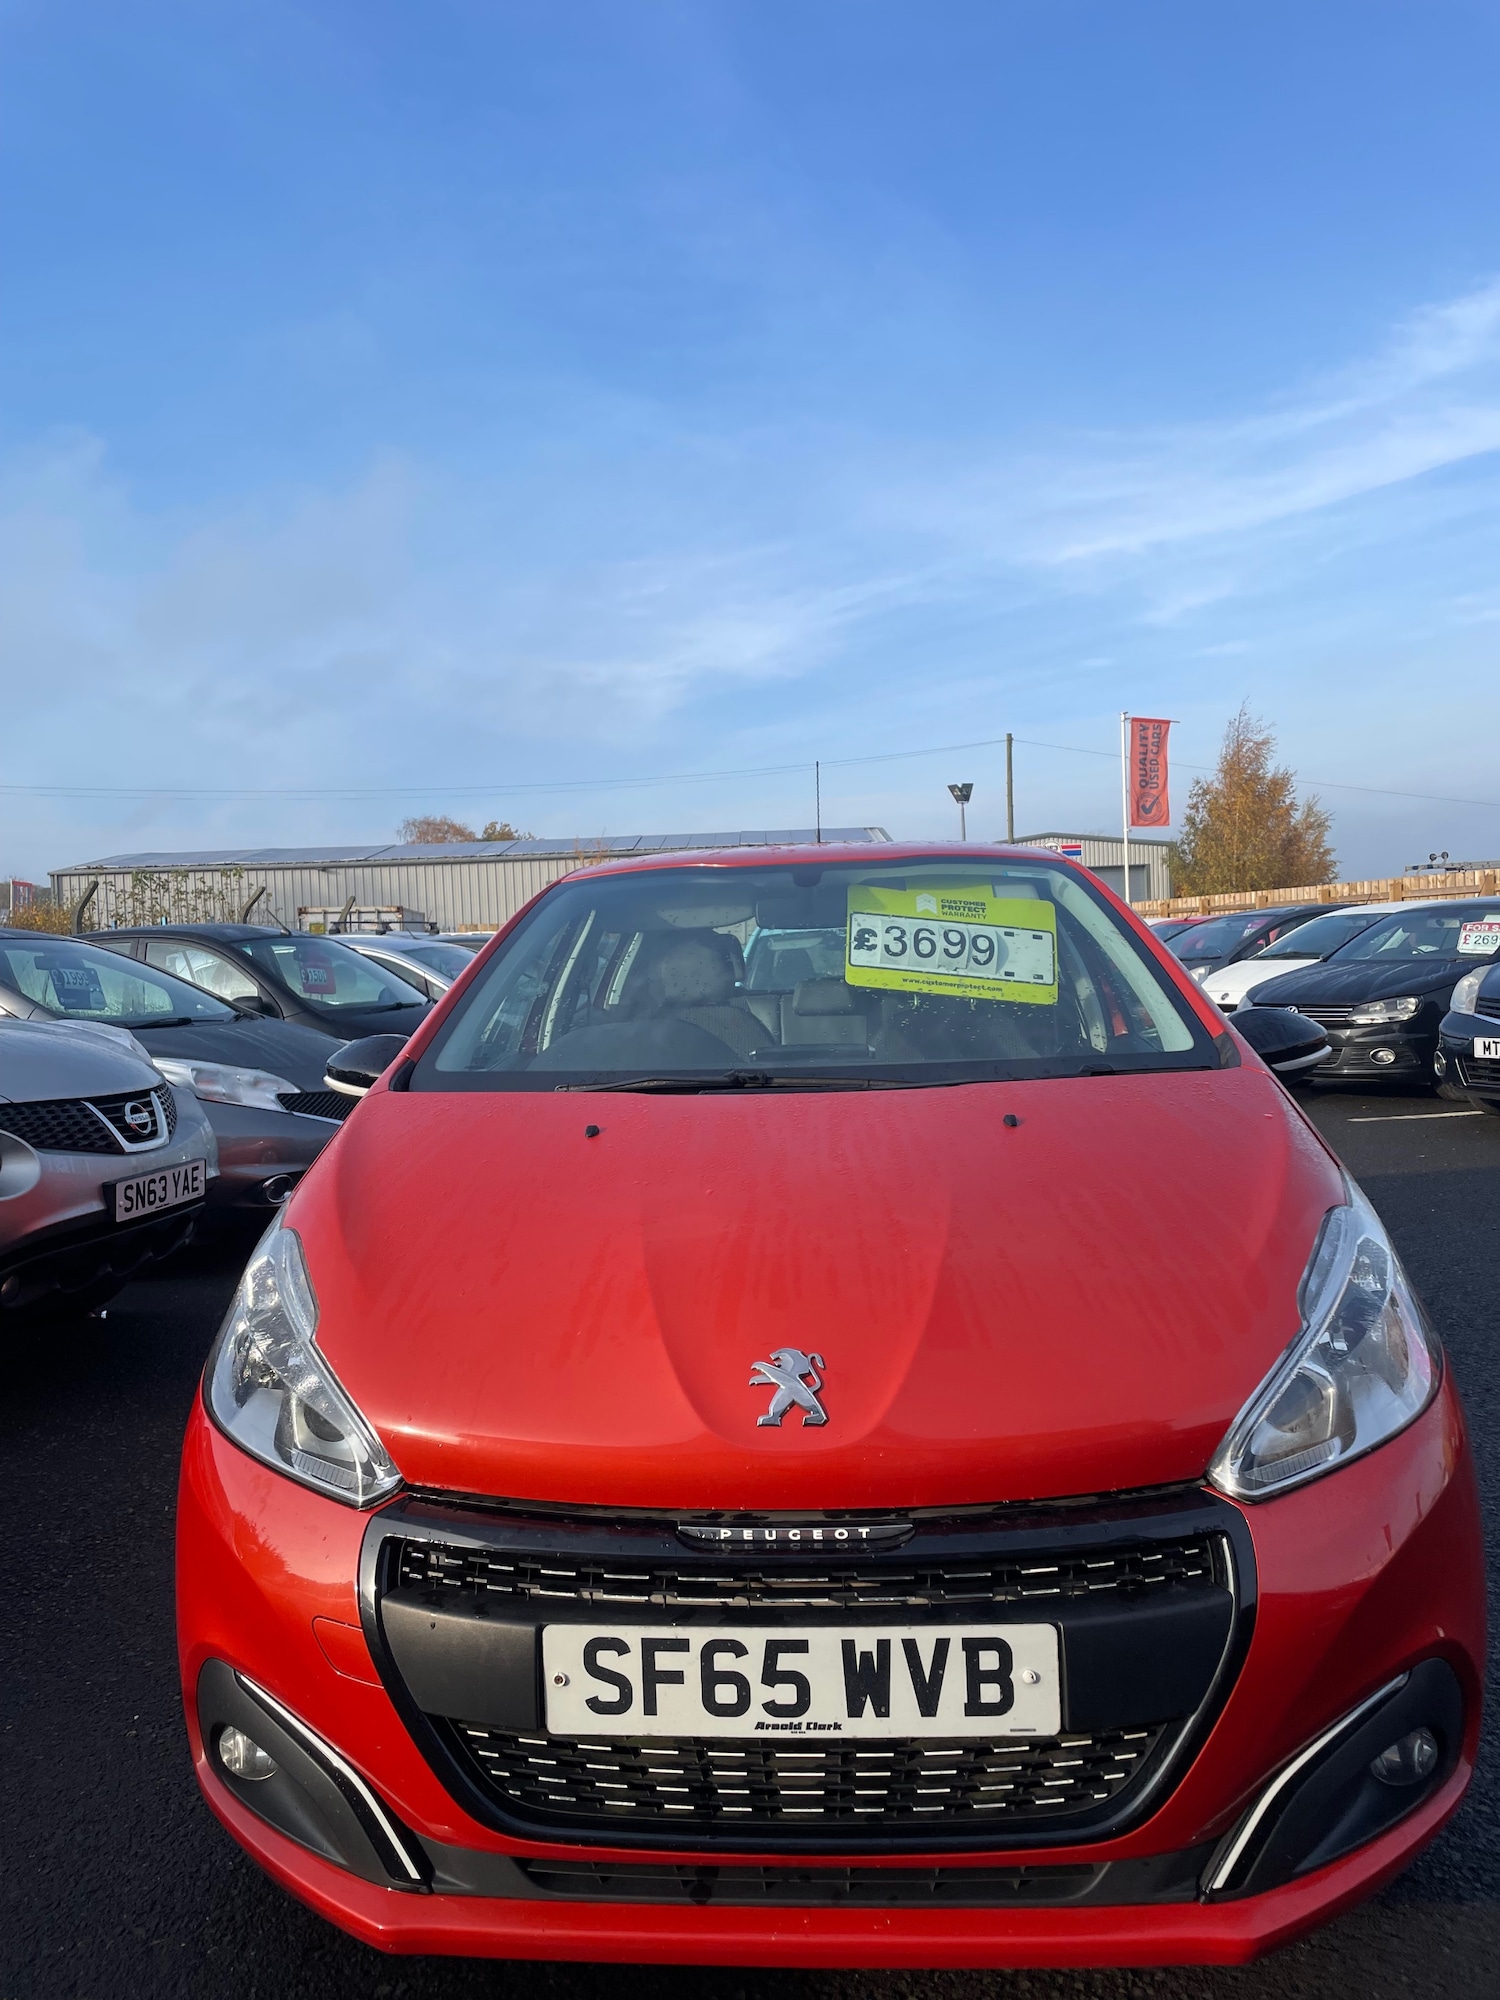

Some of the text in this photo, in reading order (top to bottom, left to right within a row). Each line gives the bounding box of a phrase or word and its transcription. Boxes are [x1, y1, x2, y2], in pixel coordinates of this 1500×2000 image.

[1151, 723, 1162, 755] CARS
[1139, 723, 1149, 789] QUALITY
[1149, 758, 1160, 790] USED
[941, 898, 986, 907] CUSTOMER
[941, 904, 987, 913] PROTECT
[941, 910, 987, 920] WARRANTY
[853, 925, 995, 966] £3699
[124, 1165, 200, 1213] SN63 YAE
[720, 1528, 871, 1541] PEUGEOT
[583, 1636, 1015, 1718] SF65 WVB
[754, 1721, 842, 1731] Arnold Clark
